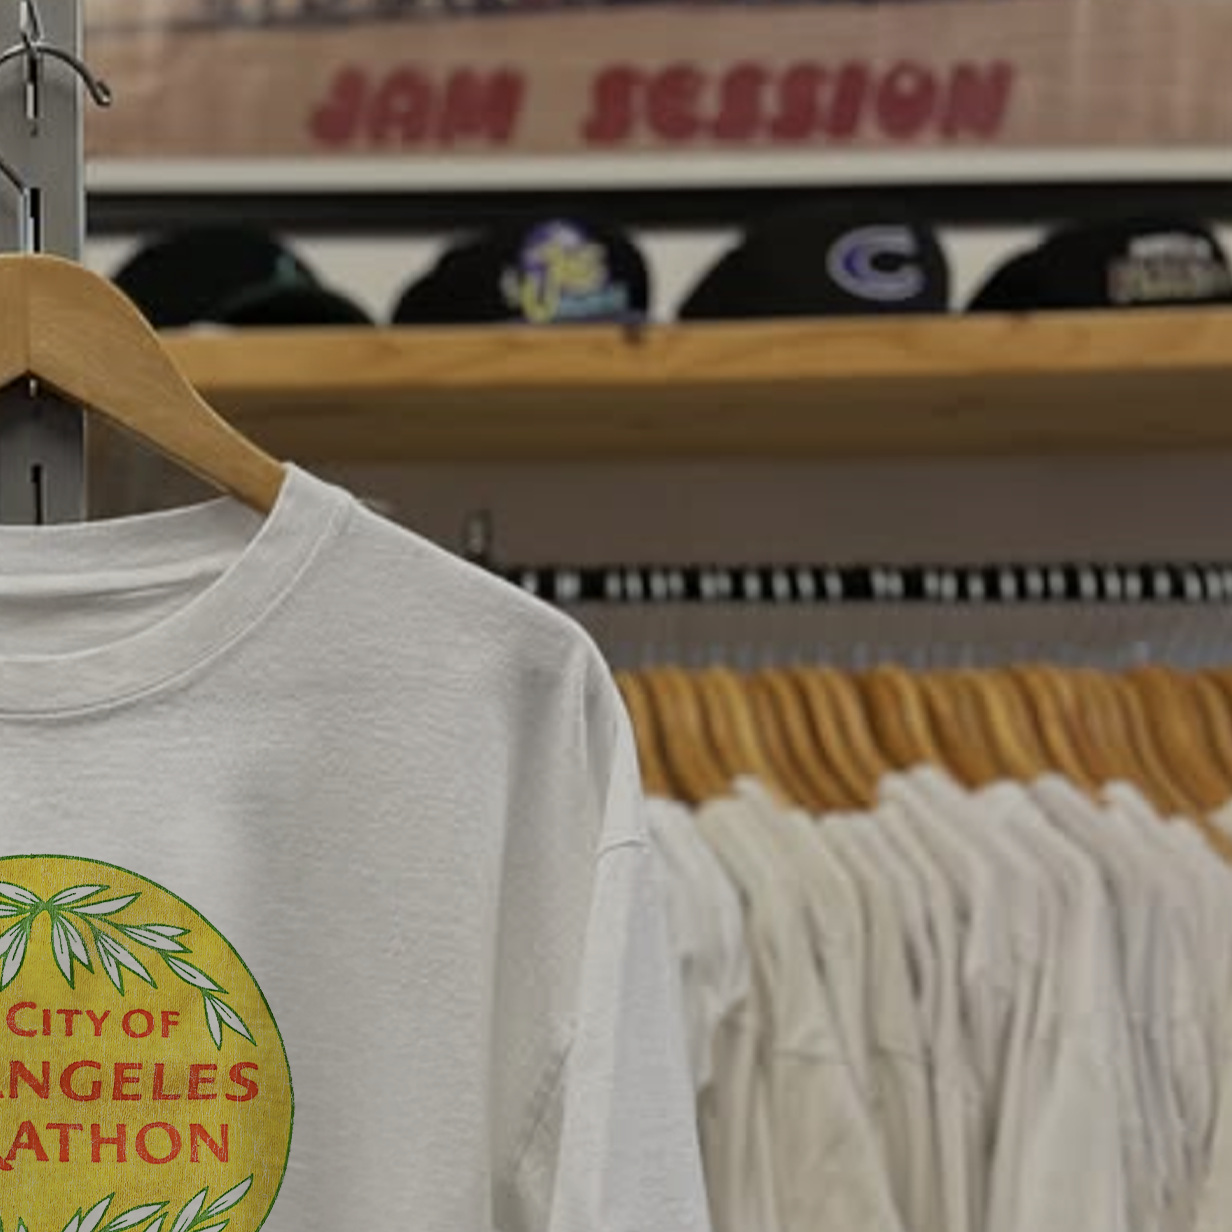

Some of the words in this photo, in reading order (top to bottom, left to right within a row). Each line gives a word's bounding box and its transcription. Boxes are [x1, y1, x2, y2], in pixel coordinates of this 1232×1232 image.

[309, 62, 526, 149] JAM
[580, 60, 1017, 148] SESSION
[5, 1000, 111, 1038] CITY
[121, 1008, 181, 1039] OF
